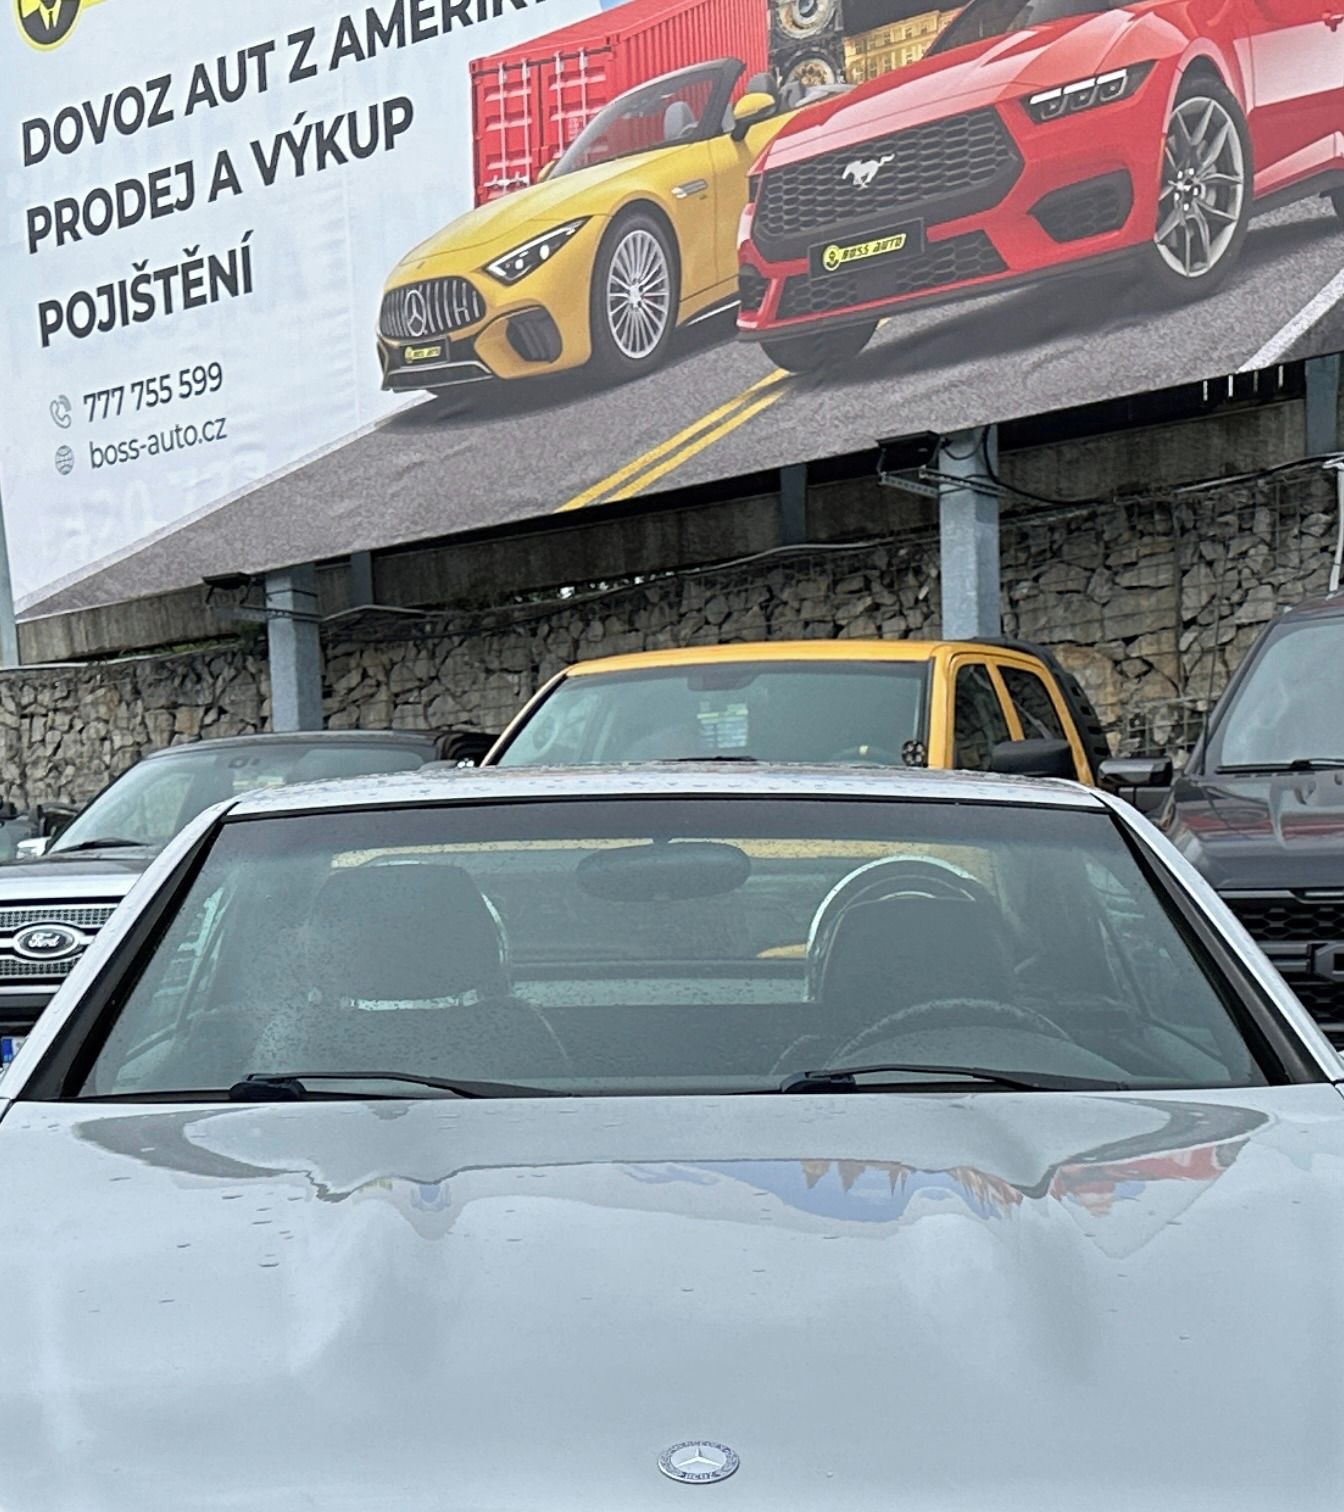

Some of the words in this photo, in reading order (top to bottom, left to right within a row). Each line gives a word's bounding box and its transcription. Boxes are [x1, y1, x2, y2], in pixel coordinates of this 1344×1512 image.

[22, 74, 174, 167] DOVOZ
[184, 40, 275, 116] AUT
[287, 27, 318, 83] Z
[27, 160, 195, 254] PRODEJ
[208, 150, 243, 202] A
[250, 96, 414, 187] VÝKUP
[38, 229, 254, 347] POJIŠTĚNÍ
[83, 386, 125, 422] 777
[131, 374, 172, 411] 755
[179, 361, 223, 399] 599
[89, 417, 228, 469] boss-auto.cz
[28, 932, 61, 948] Ford
